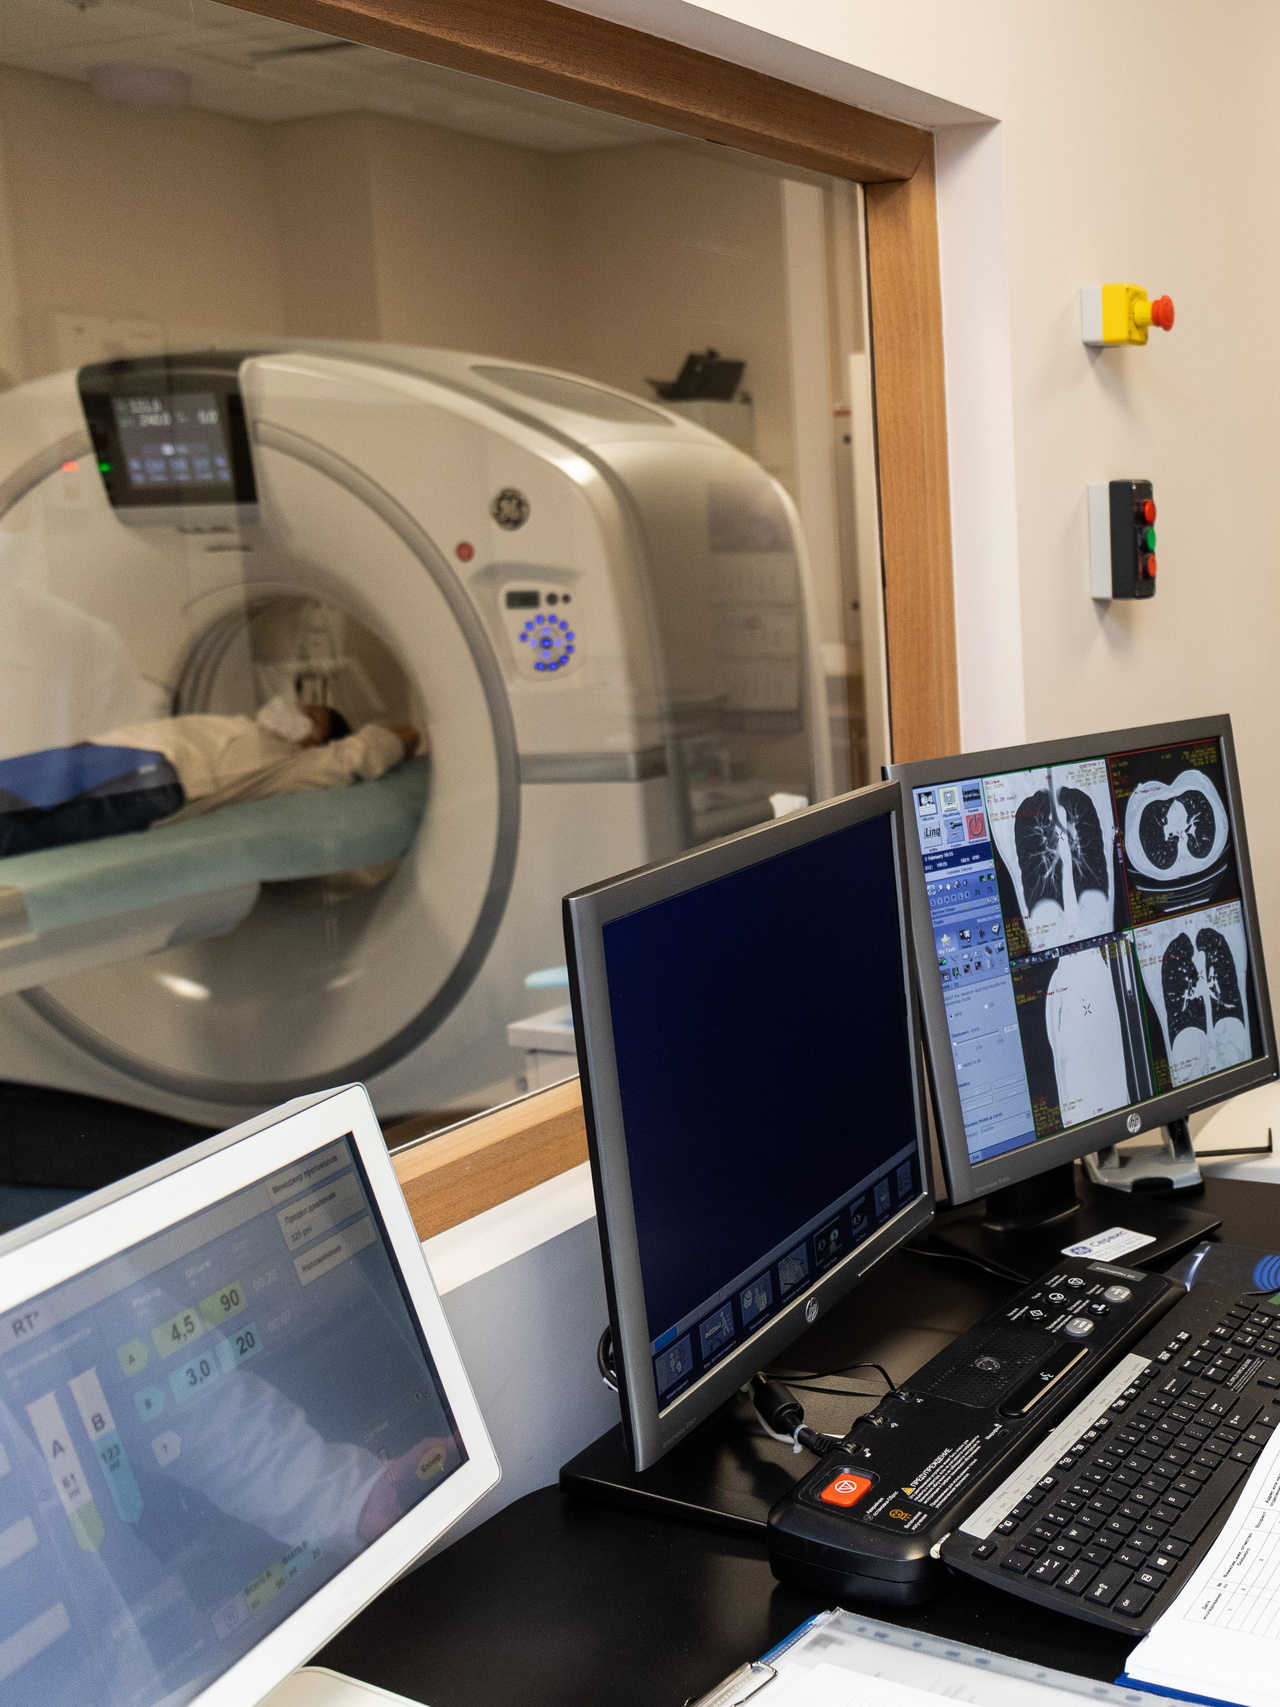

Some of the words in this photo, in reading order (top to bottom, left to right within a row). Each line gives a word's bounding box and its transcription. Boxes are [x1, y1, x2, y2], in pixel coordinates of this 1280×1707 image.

[1127, 1113, 1142, 1133] hp
[170, 1315, 196, 1345] 4,5
[219, 1288, 241, 1312] 90
[185, 1358, 212, 1389] 3,0
[235, 1330, 256, 1356] 20
[91, 1412, 106, 1431] B
[51, 1439, 65, 1459] A
[1255, 1512, 1266, 1528] Возраст
[1202, 1601, 1210, 1610] Дата
